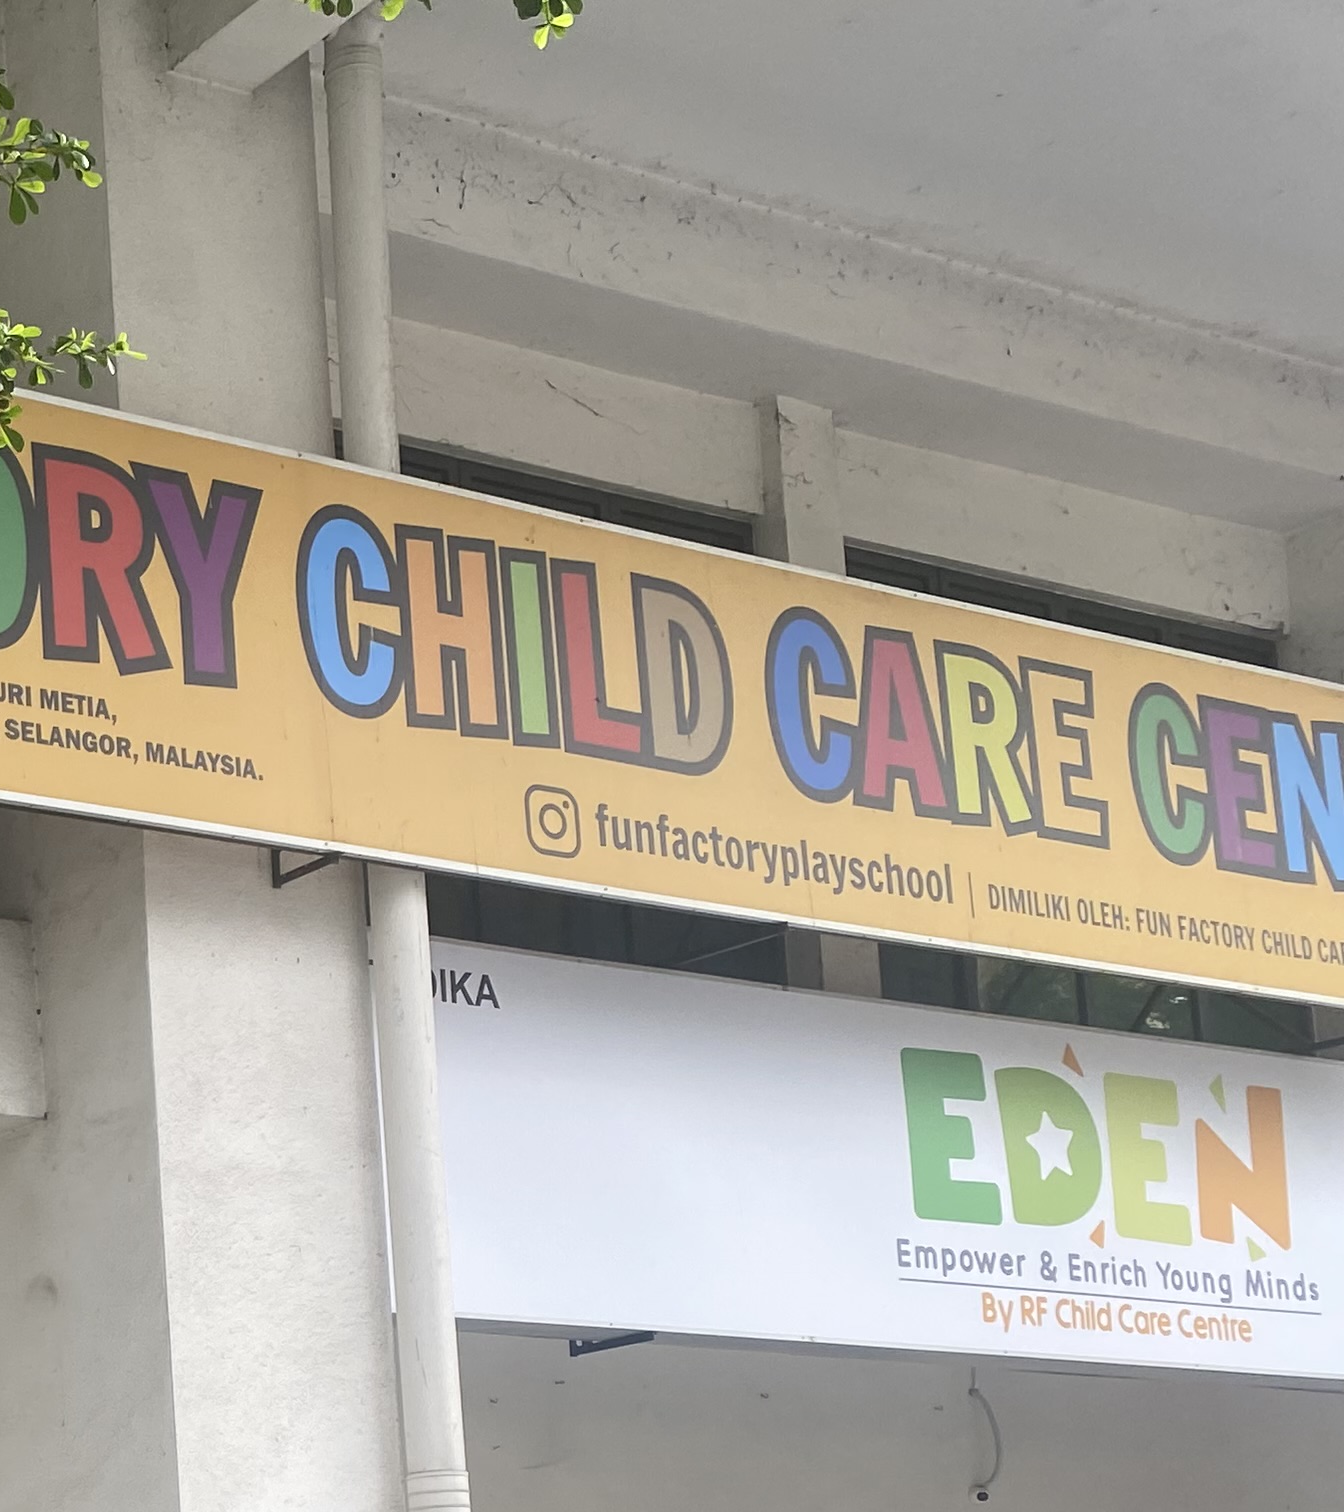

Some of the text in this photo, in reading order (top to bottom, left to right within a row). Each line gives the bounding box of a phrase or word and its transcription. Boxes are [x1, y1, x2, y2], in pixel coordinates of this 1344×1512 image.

[40, 688, 118, 725] METIA,
[296, 504, 734, 775] CHILD
[765, 606, 1110, 850] CARE
[4, 718, 139, 765] SELANGOR,
[145, 740, 264, 782] MALAYSIA.
[595, 803, 954, 904] funfactoryplayschool
[988, 883, 1071, 922] DIMILIKI
[1077, 898, 1131, 932] OLEH:
[1136, 908, 1172, 938] FUN
[1178, 915, 1255, 951] FACTORY
[1261, 928, 1313, 961] CHILD
[899, 1046, 1292, 1251] EDEN
[896, 1238, 1320, 1303] Empower & Enrich Young Minds
[981, 1292, 1253, 1342] By RF Child Care Centre
